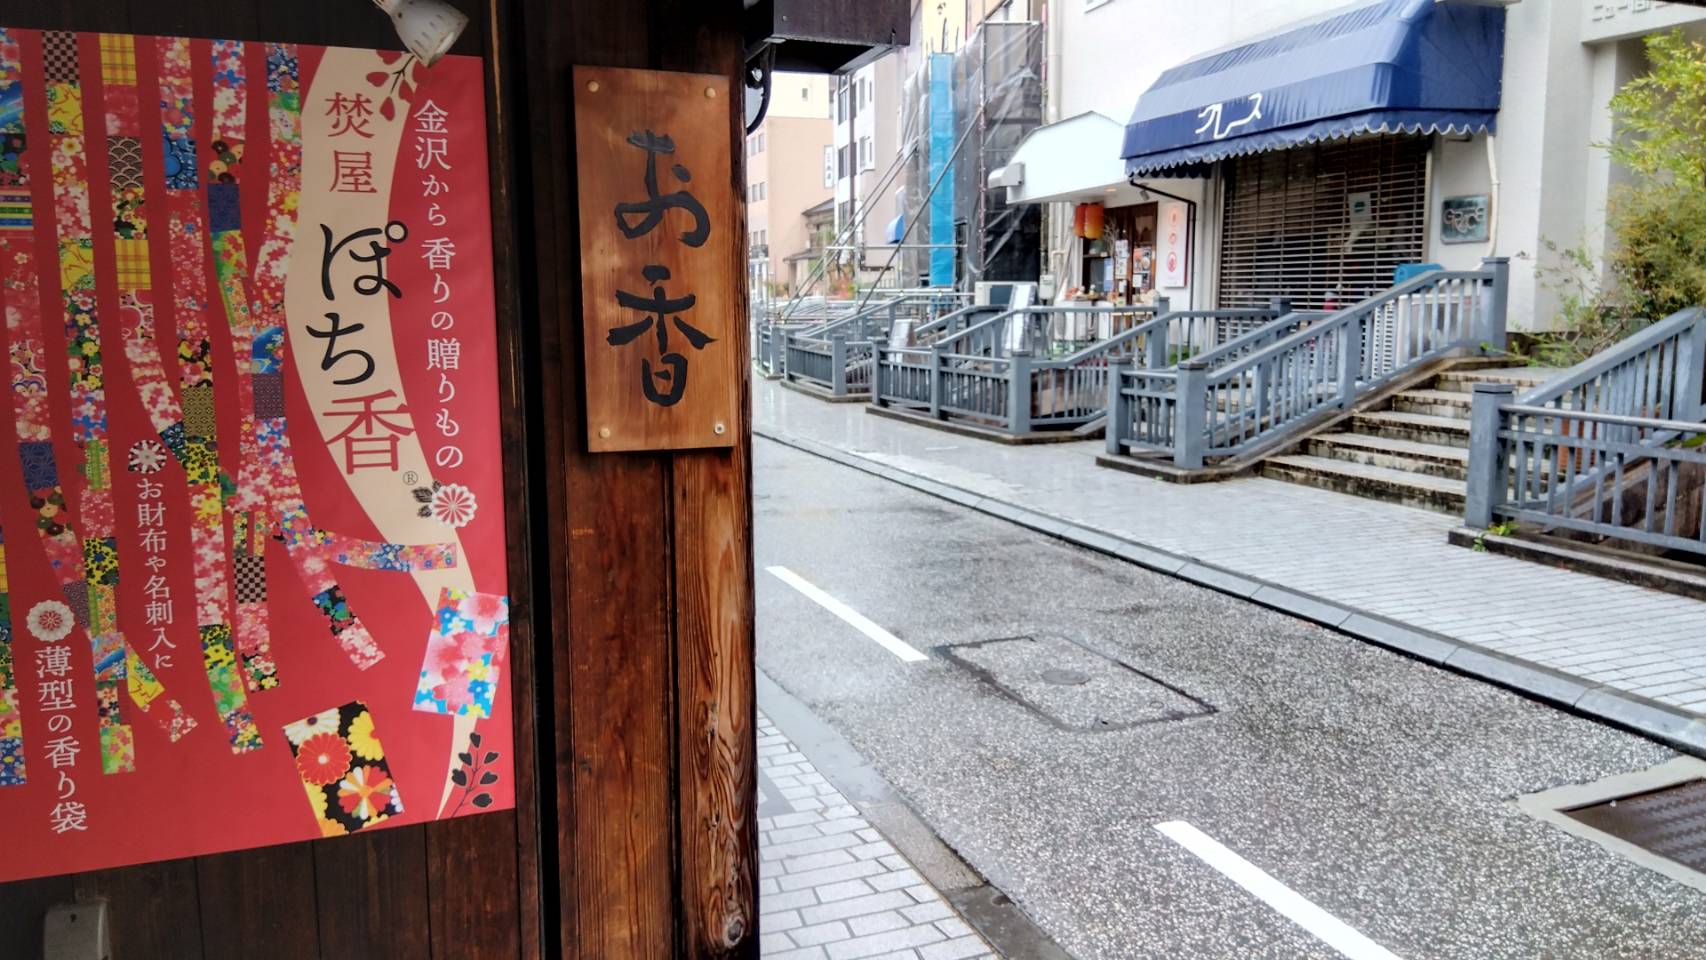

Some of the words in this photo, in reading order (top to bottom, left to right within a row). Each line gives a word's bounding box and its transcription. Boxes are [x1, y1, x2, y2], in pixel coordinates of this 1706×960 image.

[325, 93, 378, 194] 焚屋
[306, 220, 416, 475] ぽち香
[413, 100, 464, 469] 金沢から香りの贈りもの
[606, 128, 718, 408] お香
[137, 478, 174, 669] お財布や名刺入に
[34, 646, 88, 834] 薄型の香り袋
